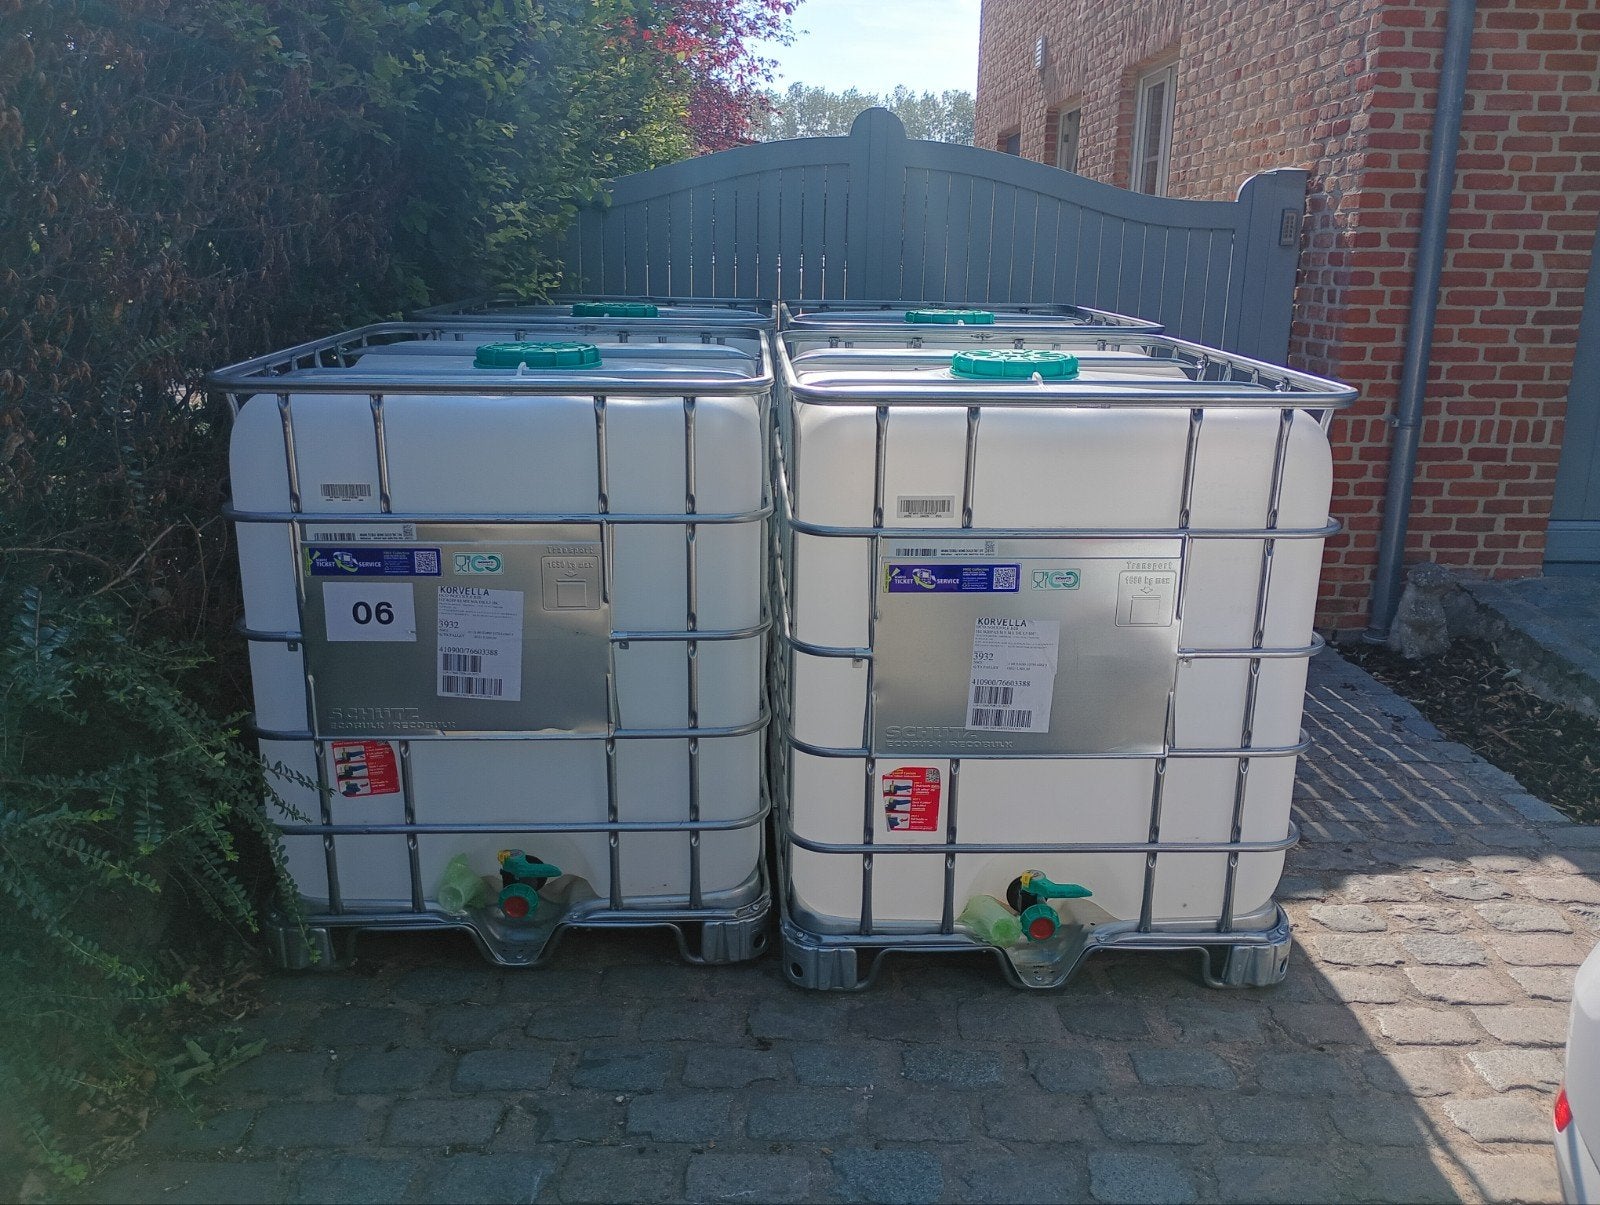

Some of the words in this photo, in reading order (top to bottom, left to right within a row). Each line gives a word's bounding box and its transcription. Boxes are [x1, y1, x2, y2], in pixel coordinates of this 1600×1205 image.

[1126, 561, 1173, 571] Transport
[440, 586, 490, 596] KORVELLA
[352, 601, 394, 625] 06
[439, 620, 459, 629] 3932
[977, 617, 1027, 628] KORVELLA
[973, 652, 994, 661] 3932
